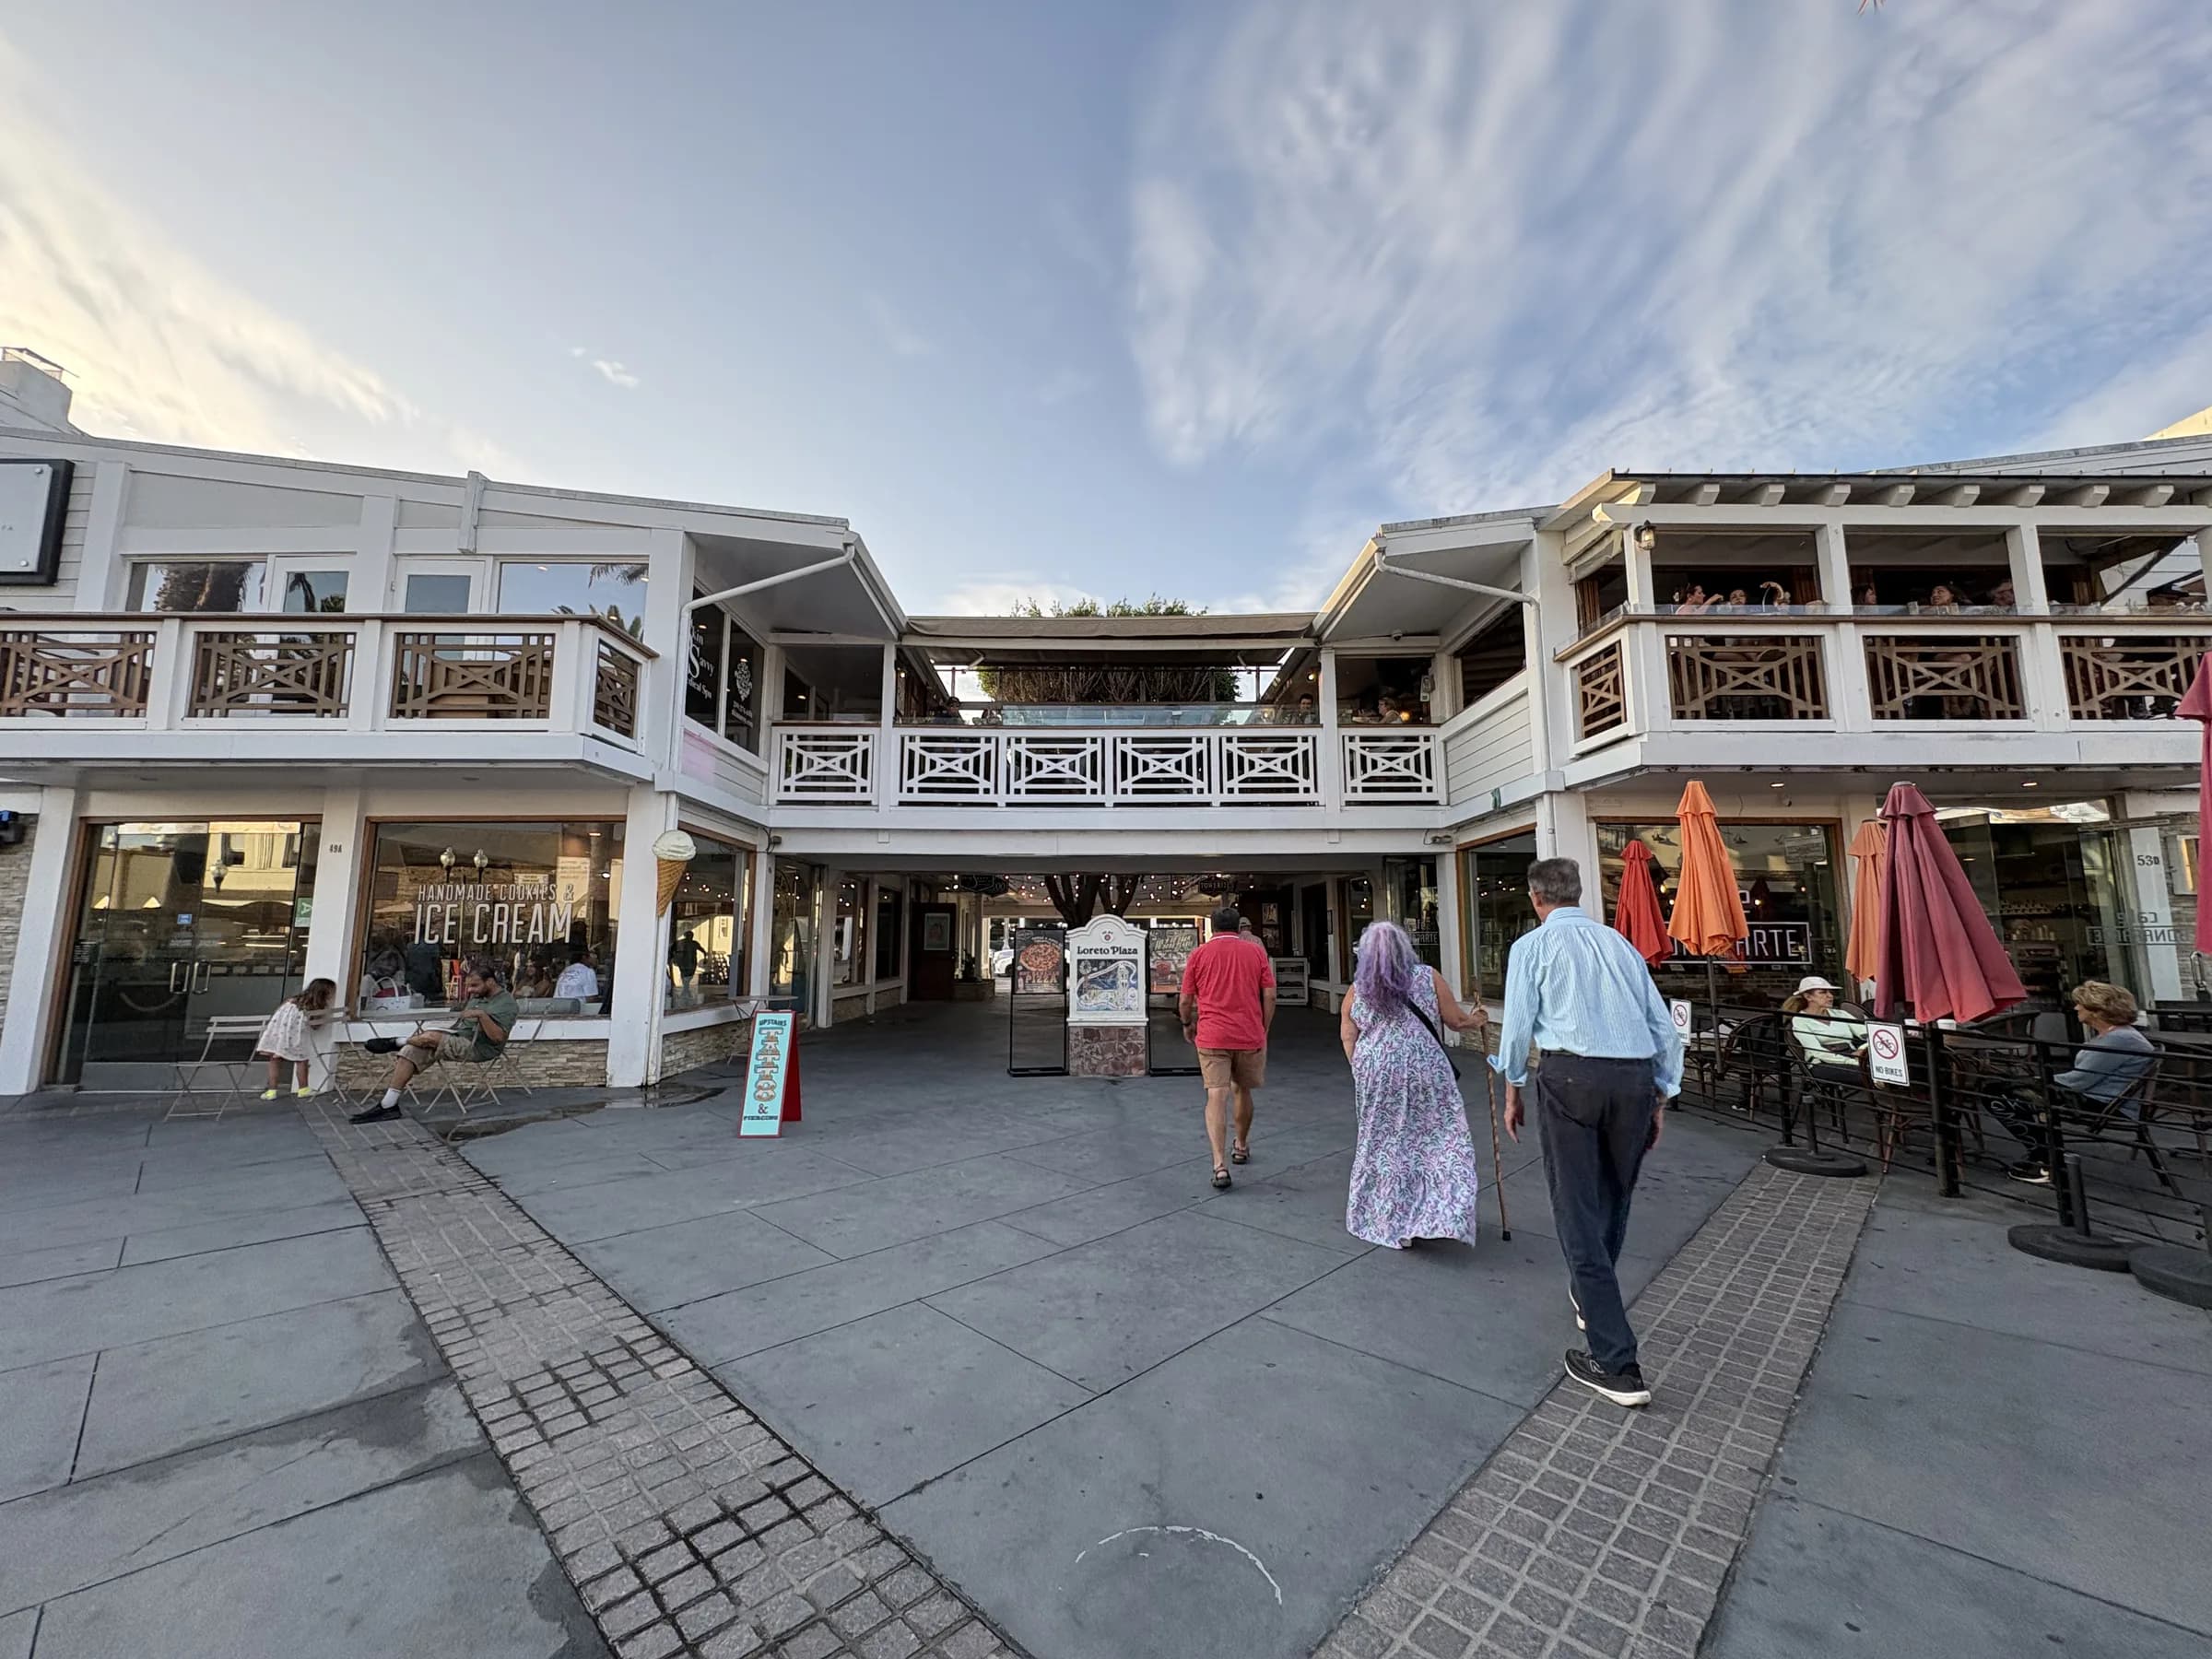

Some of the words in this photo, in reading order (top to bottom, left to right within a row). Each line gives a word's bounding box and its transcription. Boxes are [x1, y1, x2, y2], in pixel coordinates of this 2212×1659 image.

[2137, 854, 2160, 866] 53D
[418, 884, 492, 901] HANDMADE
[500, 884, 557, 900] COOKIES
[563, 884, 575, 900] &
[415, 903, 459, 945] ICE
[473, 903, 573, 945] CREAM
[1077, 946, 1110, 955] Loreto
[1110, 946, 1138, 955] Plaza
[1025, 971, 1058, 983] PIZZA
[759, 1018, 787, 1027] UPSTAIRS
[754, 1028, 784, 1102] TATTOO
[1875, 1065, 1884, 1075] NO
[1885, 1066, 1903, 1077] BIKES
[758, 1103, 769, 1114] &
